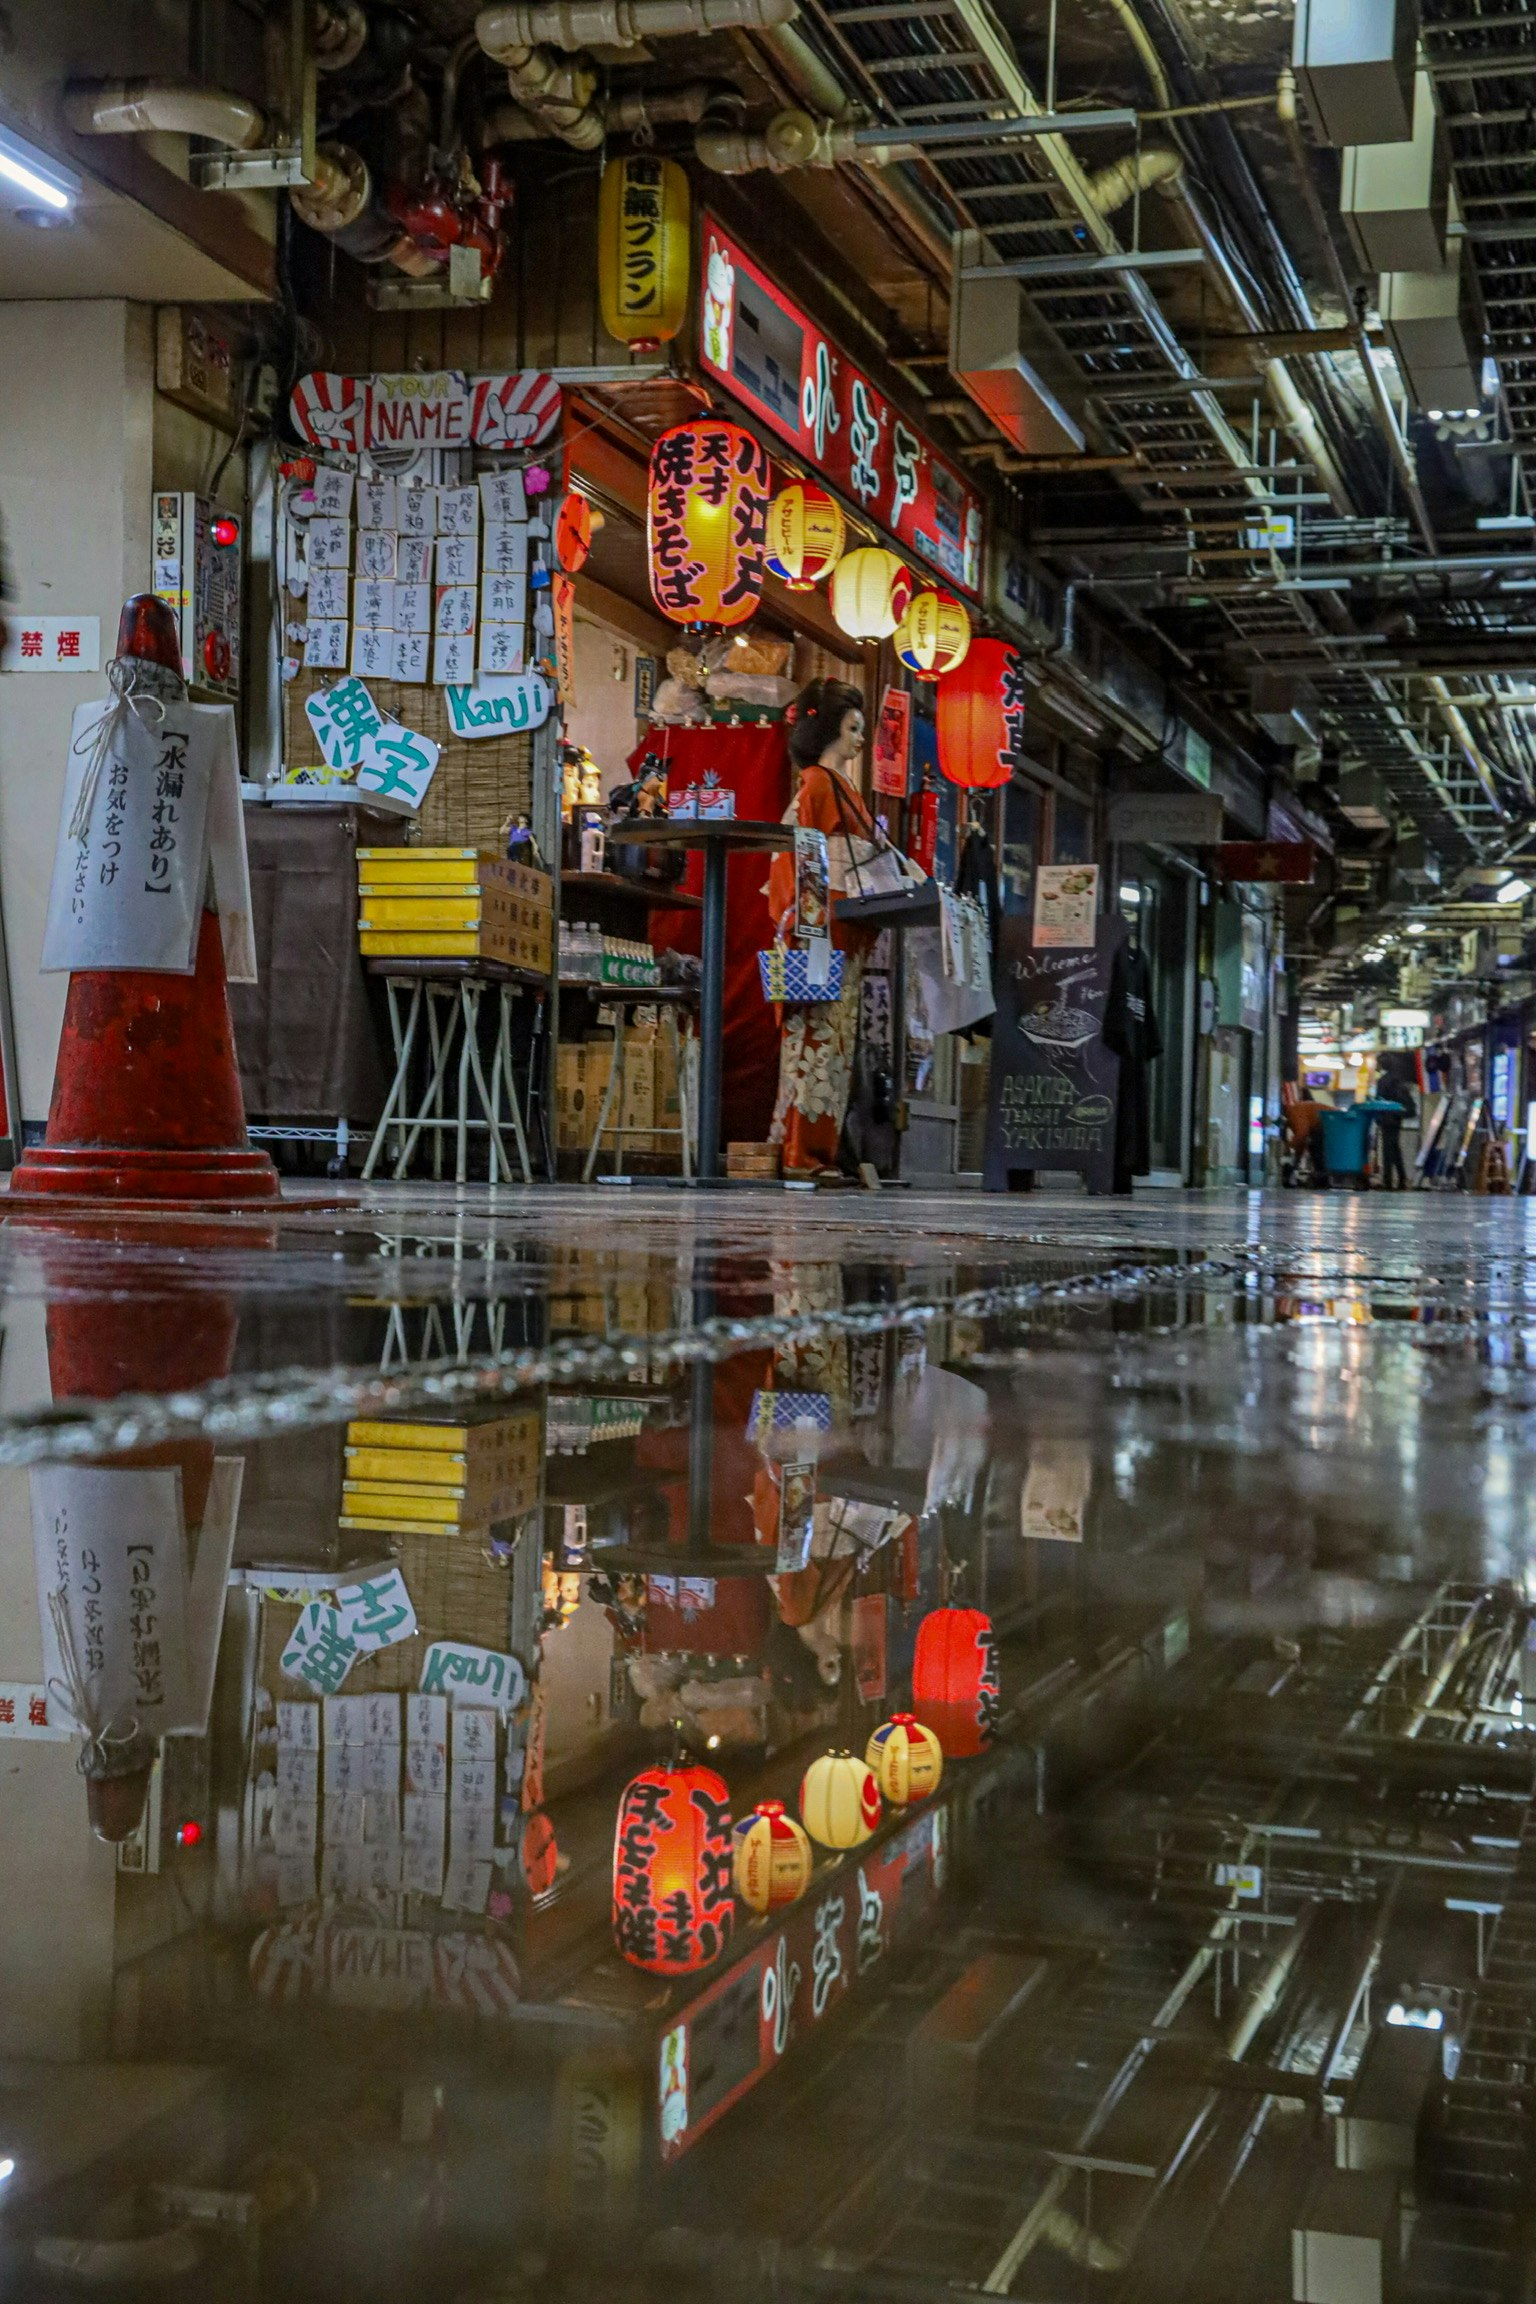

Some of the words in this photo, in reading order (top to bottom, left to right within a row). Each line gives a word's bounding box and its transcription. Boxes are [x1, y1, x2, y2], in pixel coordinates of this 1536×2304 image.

[379, 374, 450, 399] YOUR
[378, 401, 464, 441] NAME
[697, 433, 731, 505] 天才
[652, 431, 705, 610] 焼きそば
[20, 630, 81, 658] 禁煙
[447, 684, 542, 731] Kanji
[307, 679, 430, 797] 漢字
[99, 764, 129, 886] お気をつけ
[71, 827, 91, 925] ください。
[1000, 1127, 1103, 1151] YAKISOBA
